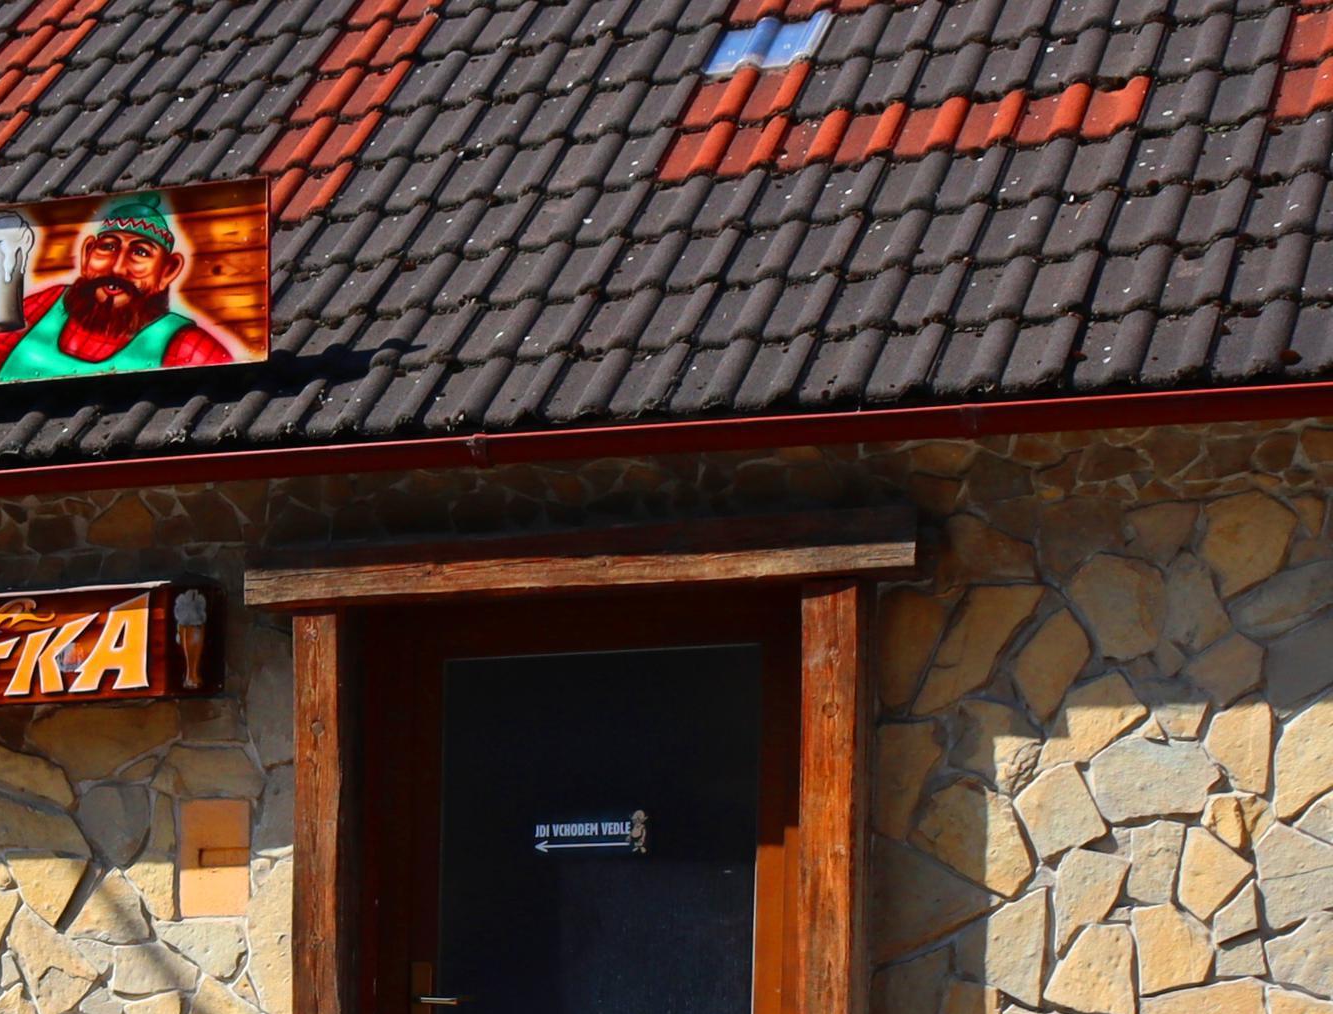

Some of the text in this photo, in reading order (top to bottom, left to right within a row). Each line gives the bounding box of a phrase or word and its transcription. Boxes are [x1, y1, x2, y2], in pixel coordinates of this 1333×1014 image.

[535, 821, 632, 838] JDI VCHODEM VEDLE
